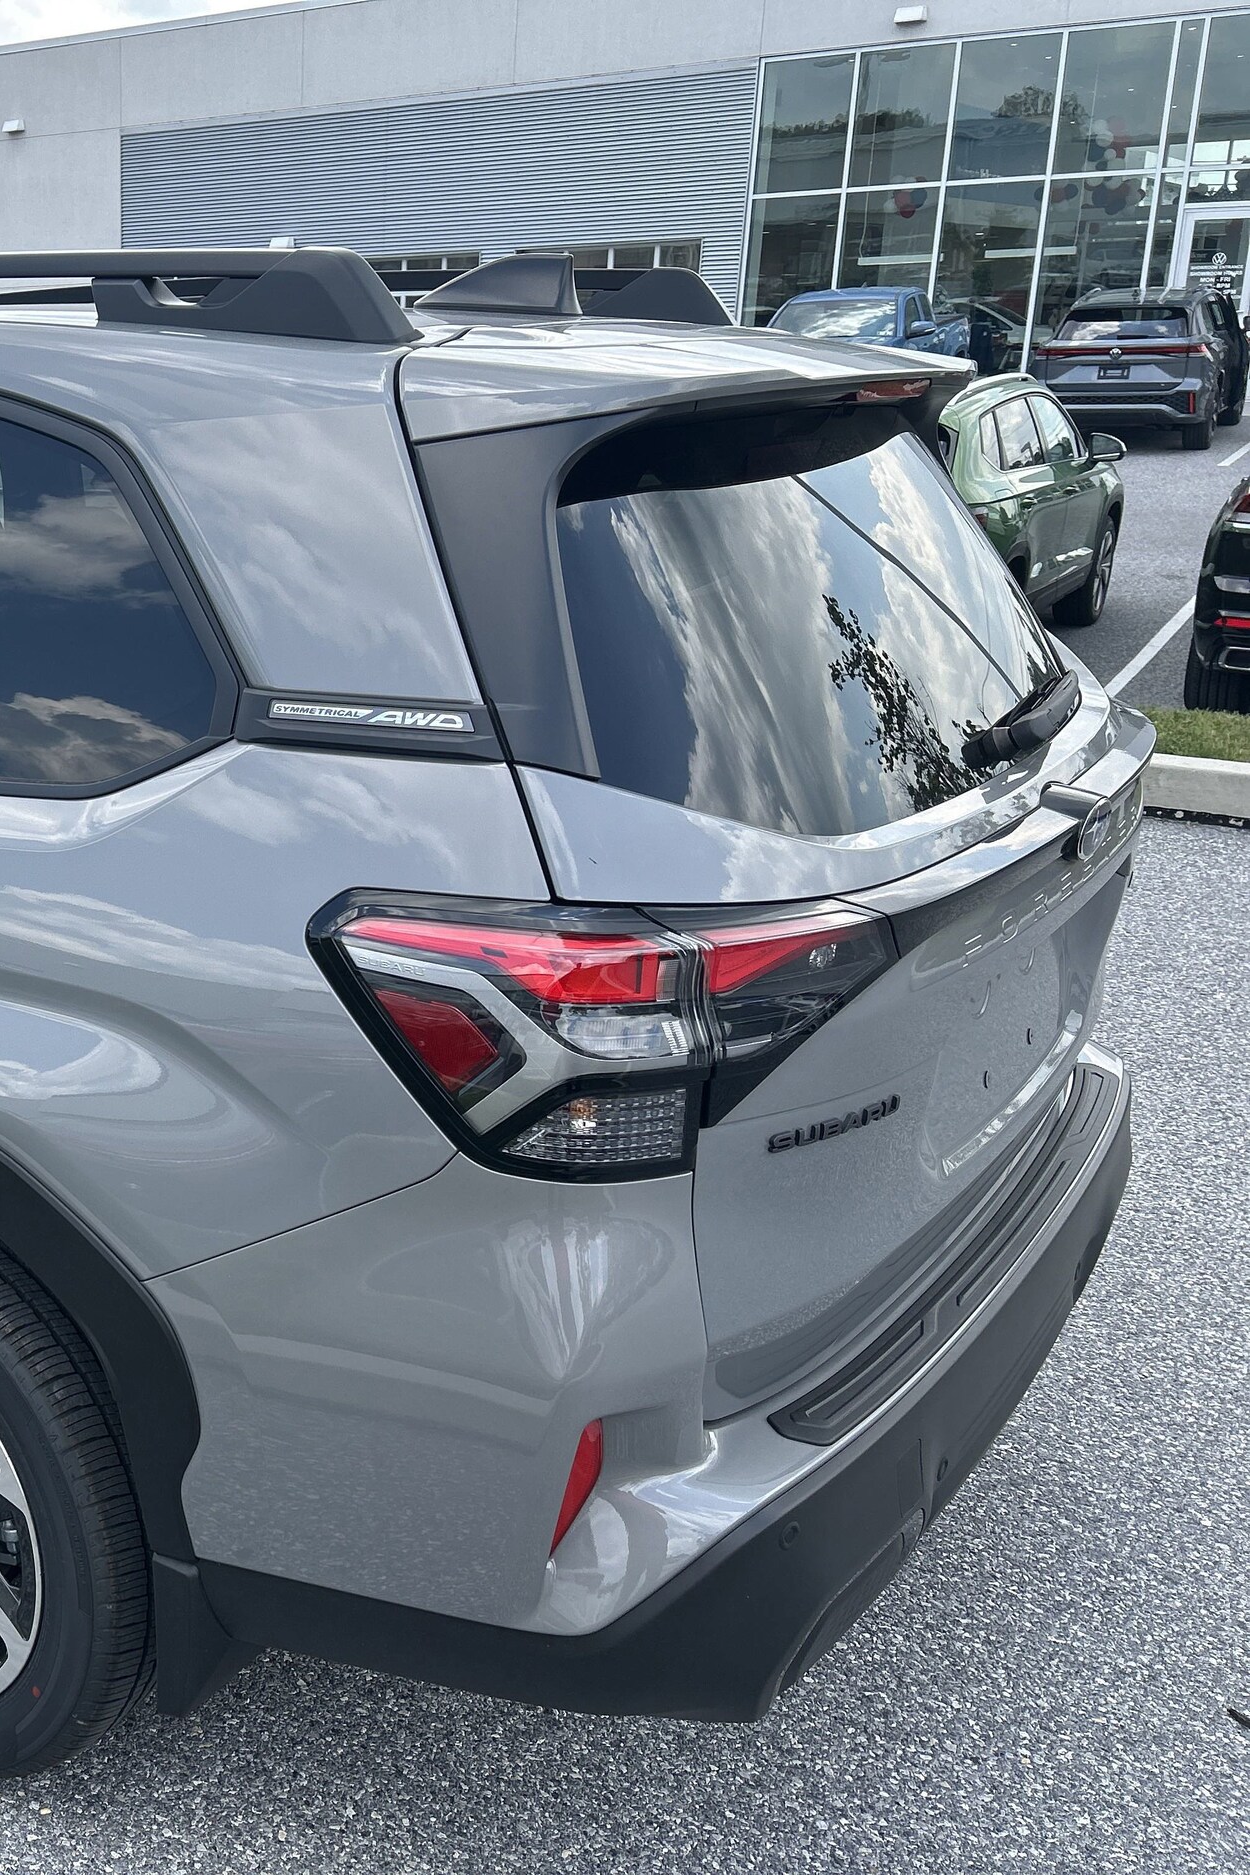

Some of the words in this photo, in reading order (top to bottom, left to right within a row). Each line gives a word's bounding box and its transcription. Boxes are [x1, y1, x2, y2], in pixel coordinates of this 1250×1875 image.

[275, 704, 361, 718] SYMMETRICAL
[367, 710, 464, 729] AWD
[357, 956, 426, 976] SUBARU
[767, 1093, 901, 1154] SUBARU
